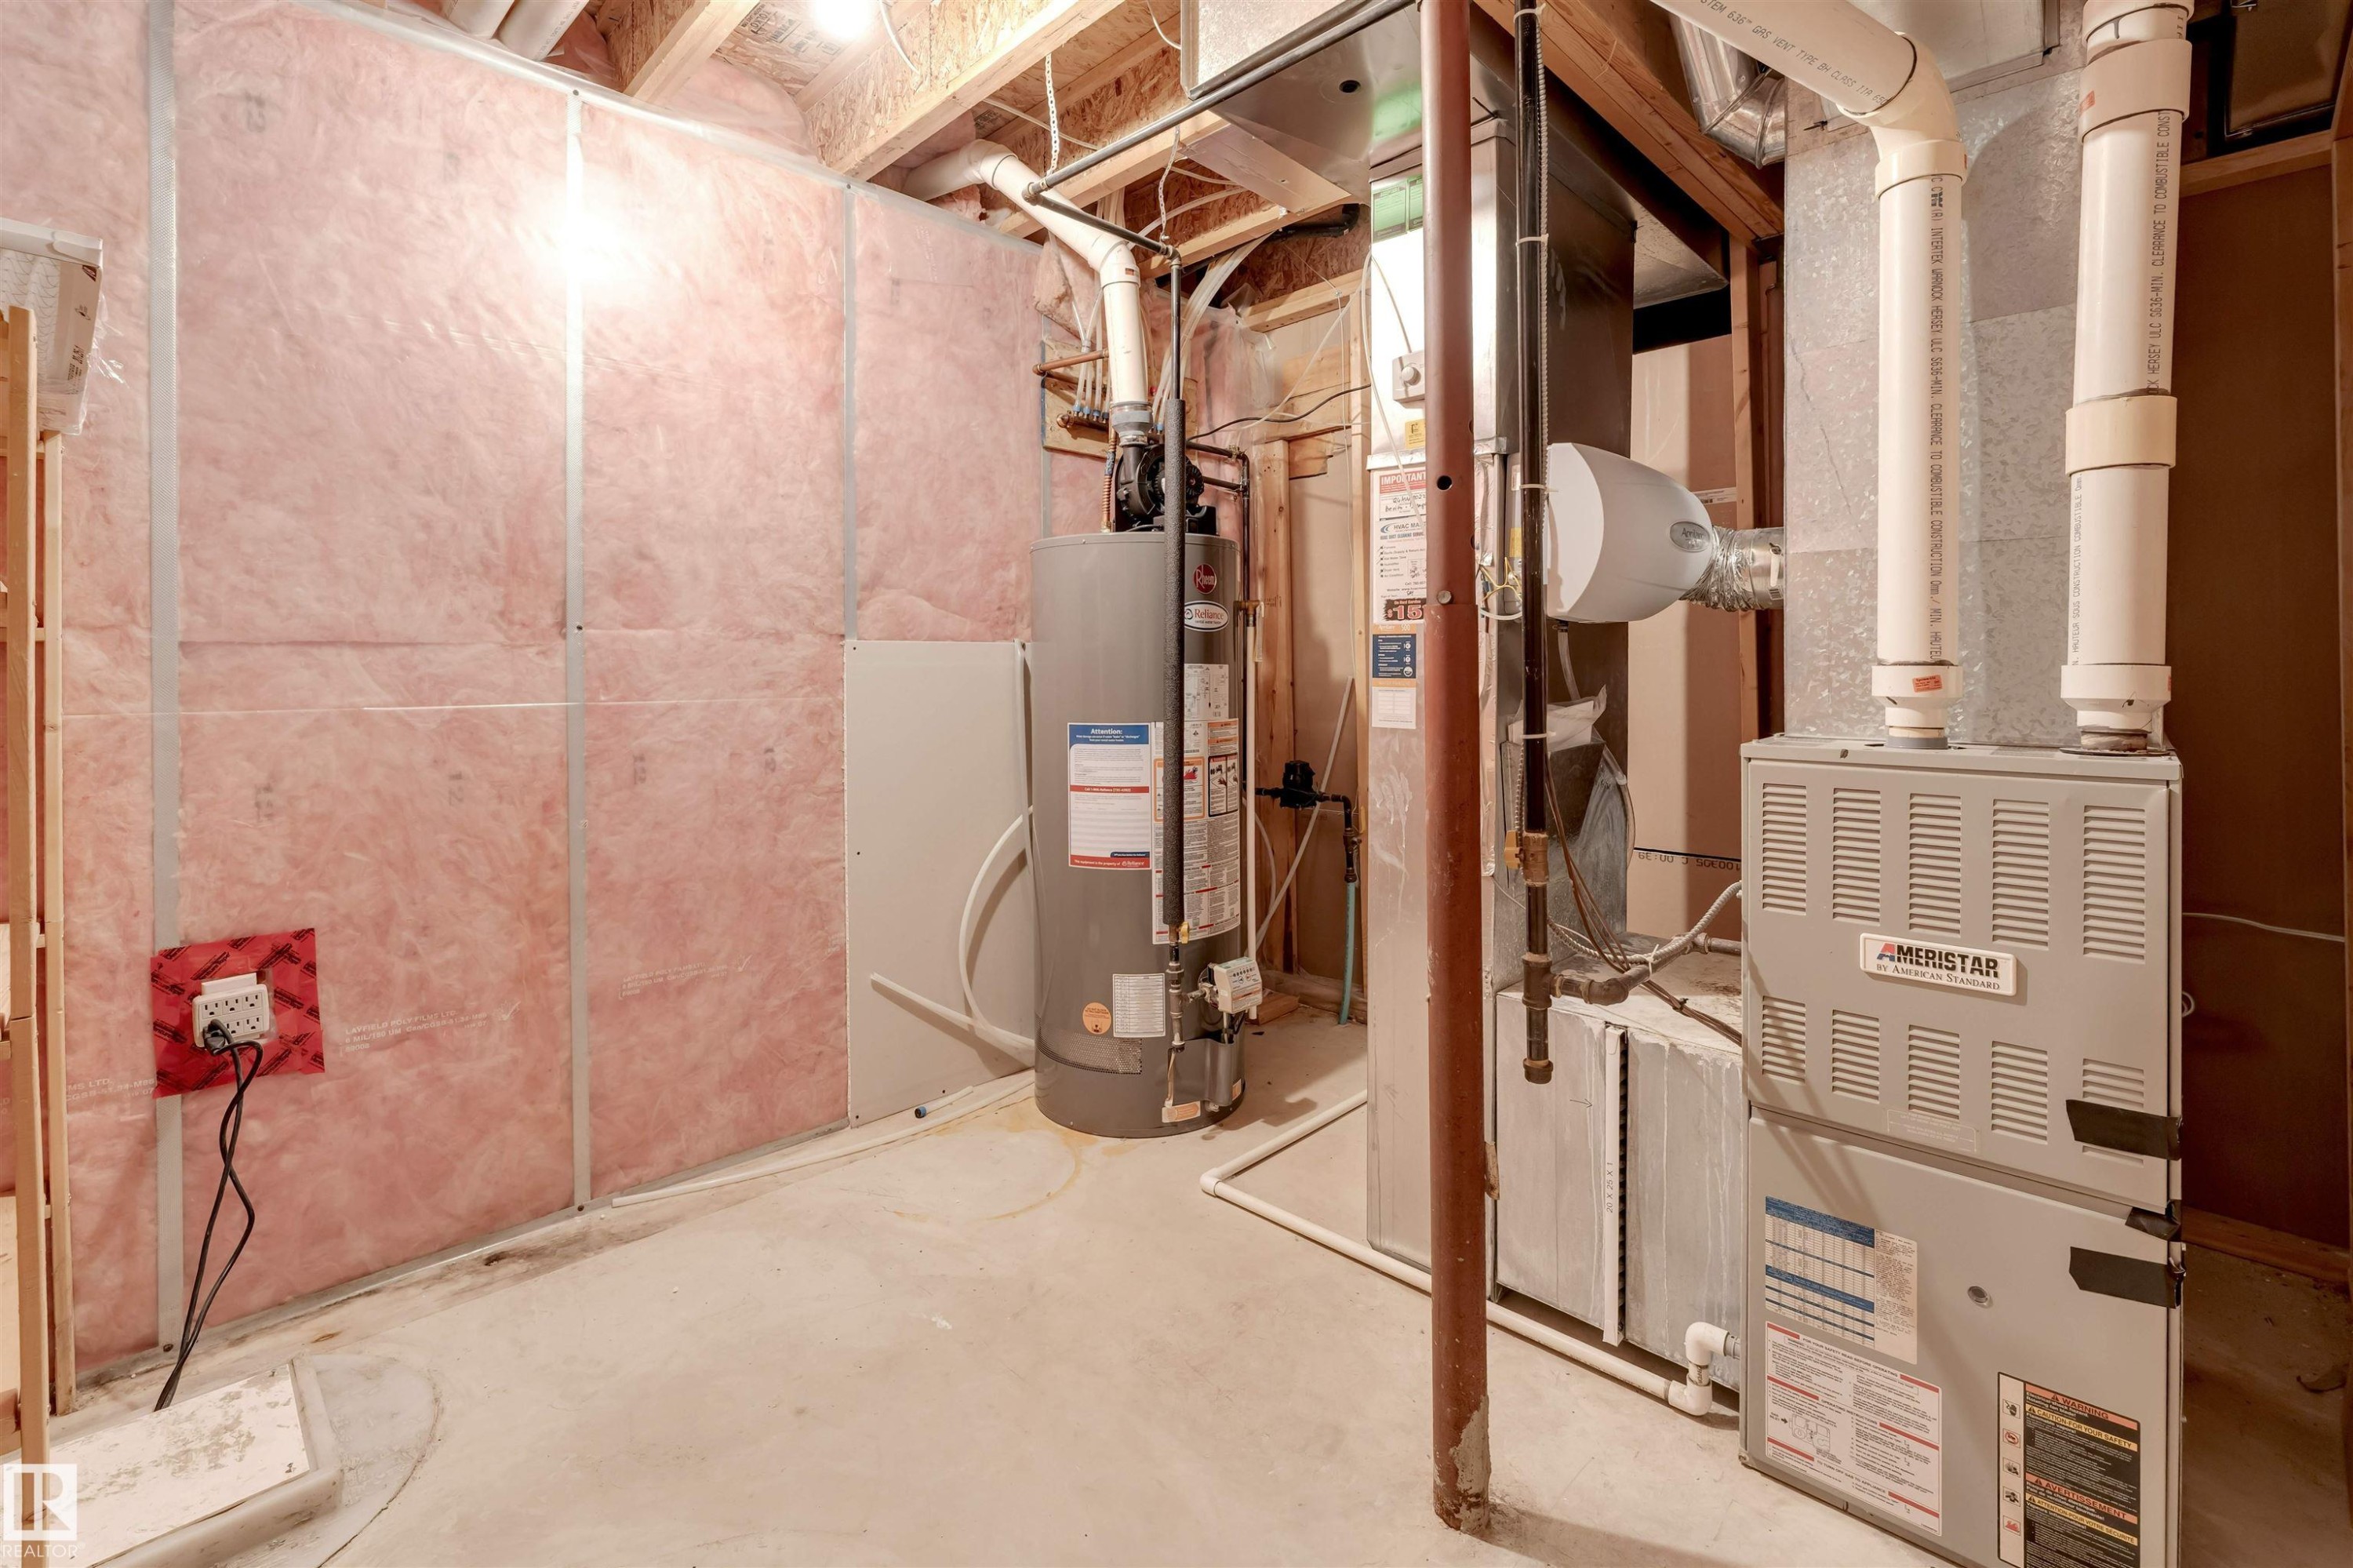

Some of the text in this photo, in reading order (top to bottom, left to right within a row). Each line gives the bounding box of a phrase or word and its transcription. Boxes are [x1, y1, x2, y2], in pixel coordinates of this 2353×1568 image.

[1752, 24, 1770, 39] GAS
[1773, 36, 1797, 52] VENT
[1797, 49, 1819, 66] TYPE
[1817, 62, 1831, 74] BH
[1831, 70, 1856, 89] CLASS
[2154, 142, 2170, 200] COMBUSTIBLE
[2154, 204, 2167, 215] TO
[1931, 227, 1944, 264] INTERTEK
[2152, 220, 2166, 266] CLEARANCE
[1931, 268, 1944, 301] WARNOCK
[1931, 306, 1944, 333] HERSEY
[2149, 323, 2162, 338] ULC
[1931, 338, 1944, 353] ULC
[2148, 343, 2162, 374] HERSEY
[1930, 403, 1943, 446] CLEARANCE
[1930, 450, 1942, 460] TO
[1930, 464, 1942, 515] COMBUSTIBLE
[2074, 495, 2082, 542] COMBUSTIBLE
[1930, 520, 1942, 577] CONSTRUCTION
[1195, 565, 1215, 588] Rheem
[2073, 545, 2081, 598] CONSTRUCTION
[1195, 608, 1224, 620] Reliance
[1929, 608, 1942, 627] MIN.
[1877, 943, 1998, 978] AMERISTAR
[1877, 963, 1888, 972] BY
[345, 1021, 389, 1035] LAYFIELD
[390, 1017, 412, 1027] POLY
[415, 1013, 440, 1024] FILMS
[388, 1028, 402, 1036] UM
[1824, 1345, 1841, 1355] SAFETY
[1853, 1357, 1871, 1367] BEFORE
[1872, 1361, 1898, 1379] OPERATING
[1821, 1399, 1846, 1413] OPERATING
[1846, 1410, 1878, 1425] INSTRUCTIONS
[2026, 1392, 2051, 1404] Electrical
[2051, 1401, 2068, 1410] shock
[2026, 1396, 2049, 1408] Rotating
[2061, 1397, 2109, 1419] WARNING
[2037, 1409, 2132, 1448] CAUTION-FOR YOUR SAFETY
[1823, 1462, 1835, 1471] TURN
[1862, 1479, 1887, 1494] APPLIANCE
[2026, 1501, 2048, 1514] Vapeurs
[2045, 1482, 2126, 1519] AVERTISSEMENT
[2046, 1493, 2076, 1509] ventilateur
[2053, 1492, 2067, 1501] choc
[2037, 1499, 2085, 1523] ATTENTION-POUR
[2085, 1519, 2105, 1531] VOTRE
